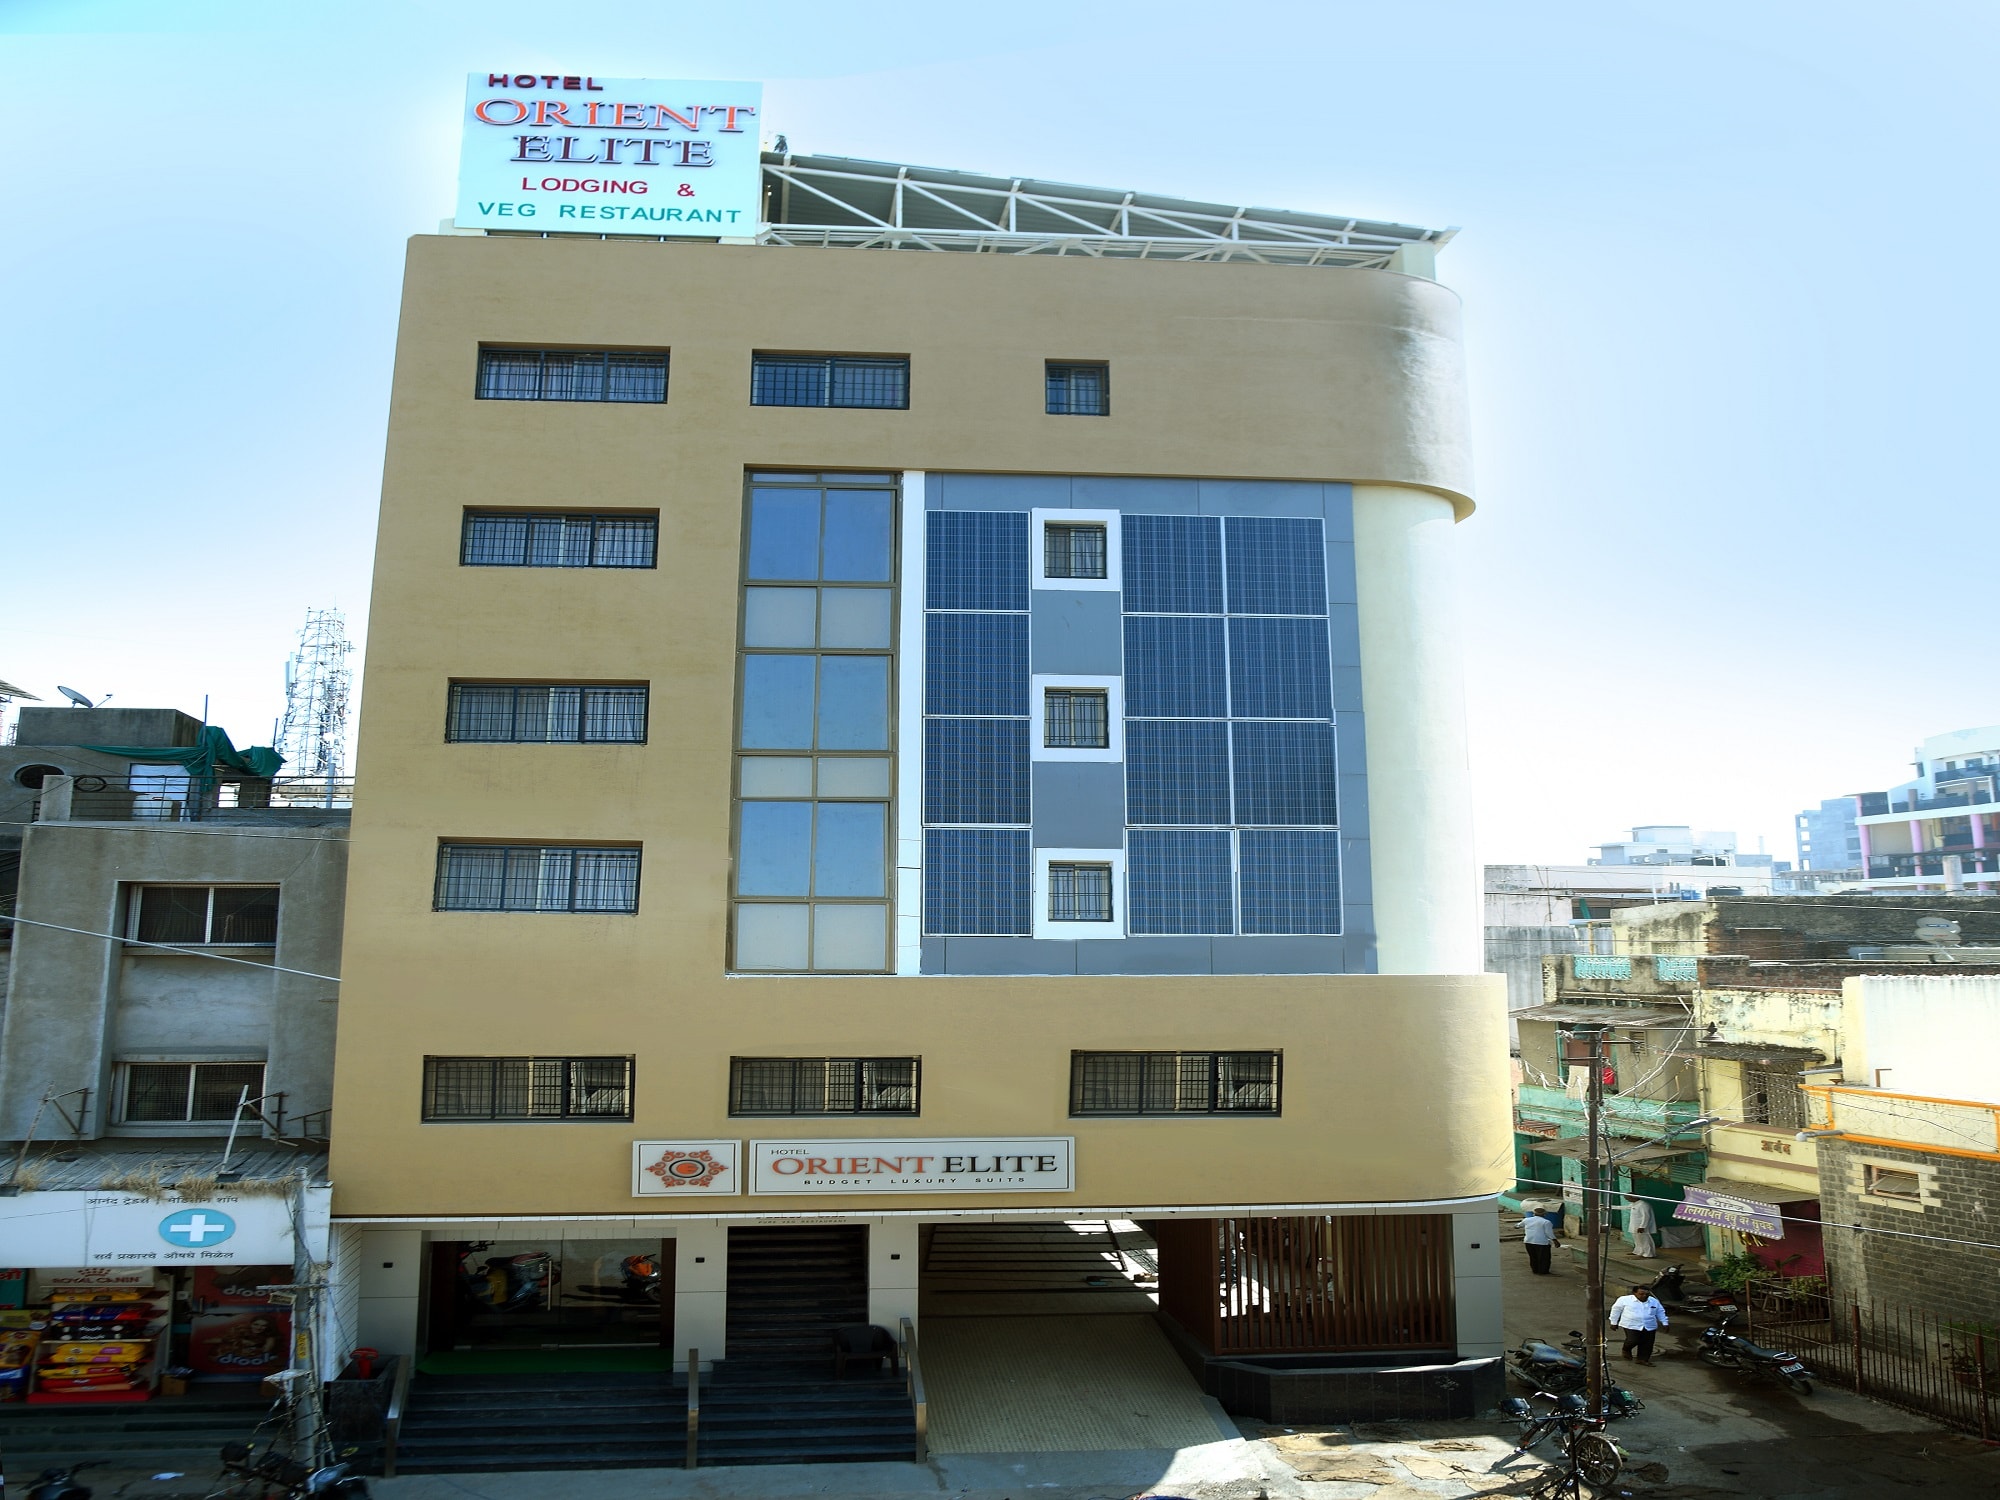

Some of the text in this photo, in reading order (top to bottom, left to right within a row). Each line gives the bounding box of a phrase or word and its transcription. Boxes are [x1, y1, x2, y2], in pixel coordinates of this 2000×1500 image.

[488, 73, 603, 91] HOTEL
[473, 98, 756, 132] ORIENT
[510, 135, 716, 167] ELITE
[521, 177, 695, 197] LODGING &
[478, 202, 741, 223] VEG RESTAURANT
[772, 1155, 1058, 1175] ORIENT ELITE
